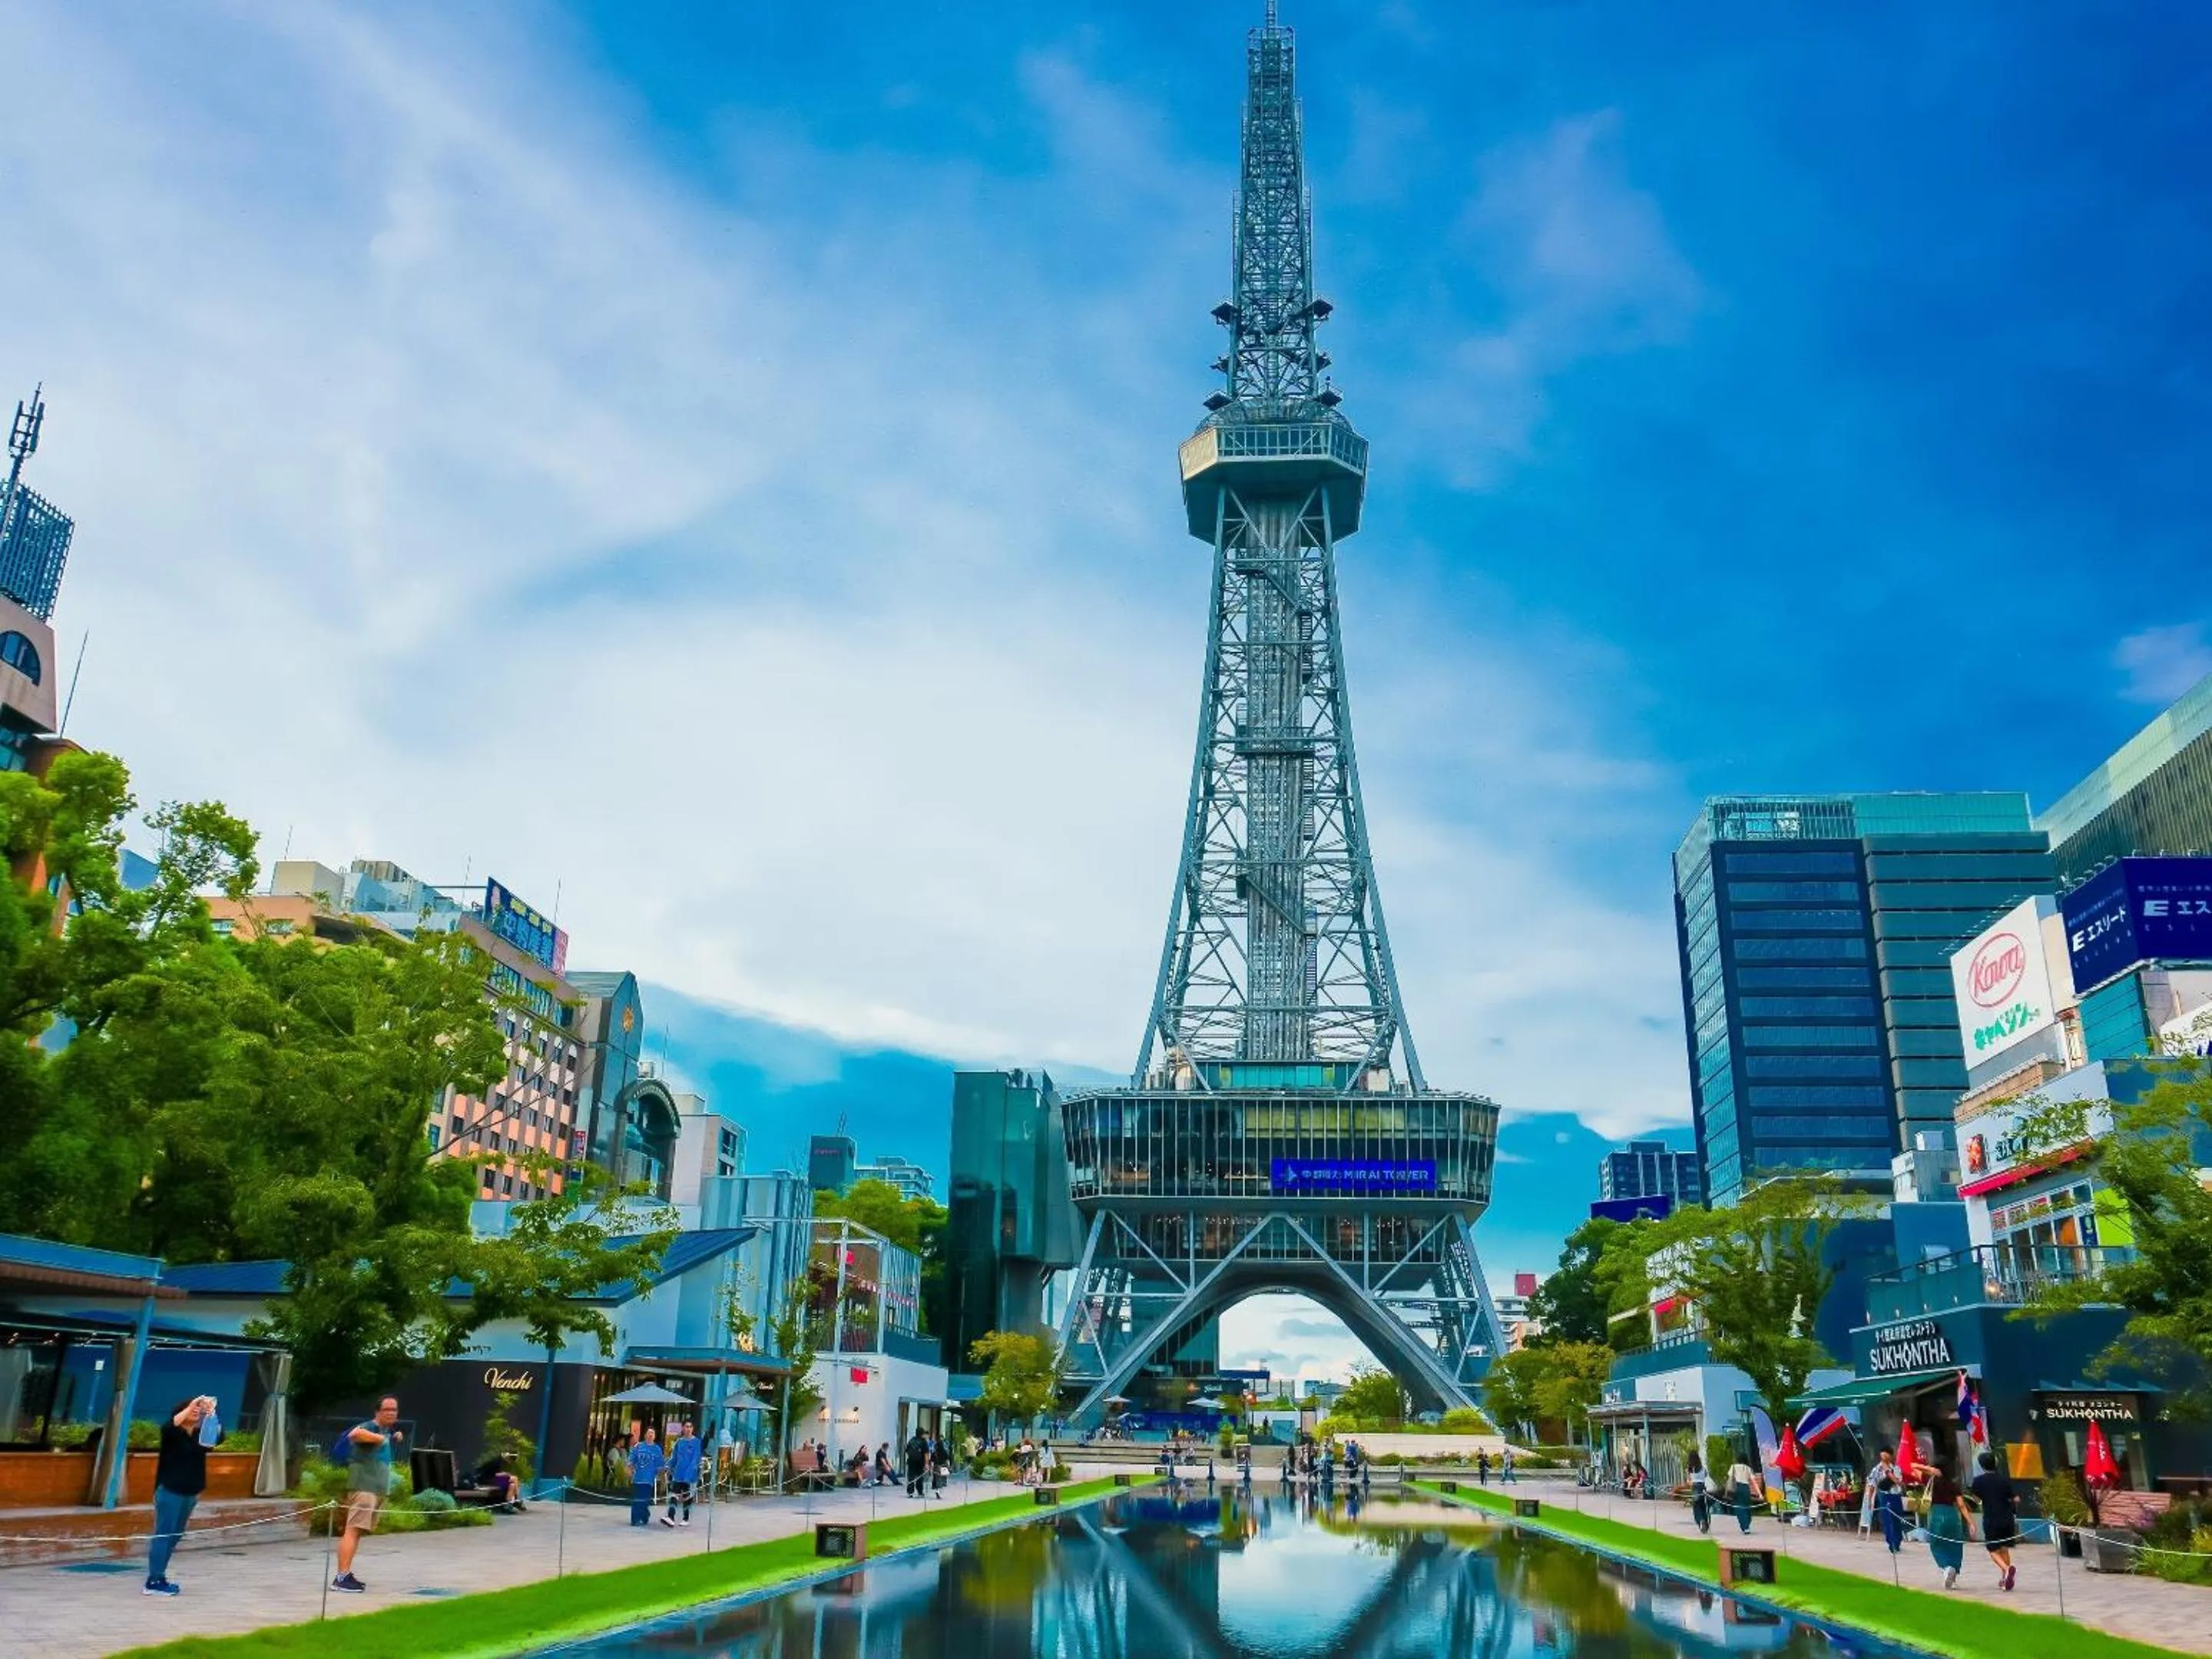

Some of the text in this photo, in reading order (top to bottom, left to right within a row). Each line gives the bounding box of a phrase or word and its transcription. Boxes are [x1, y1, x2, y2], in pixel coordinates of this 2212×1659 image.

[1343, 1170, 1380, 1180] MIRAI
[1382, 1170, 1429, 1180] TOWER
[1869, 1337, 1950, 1371] SUKHONTHA
[485, 1367, 534, 1390] Venchi
[2046, 1407, 2134, 1420] SUKHONTHA
